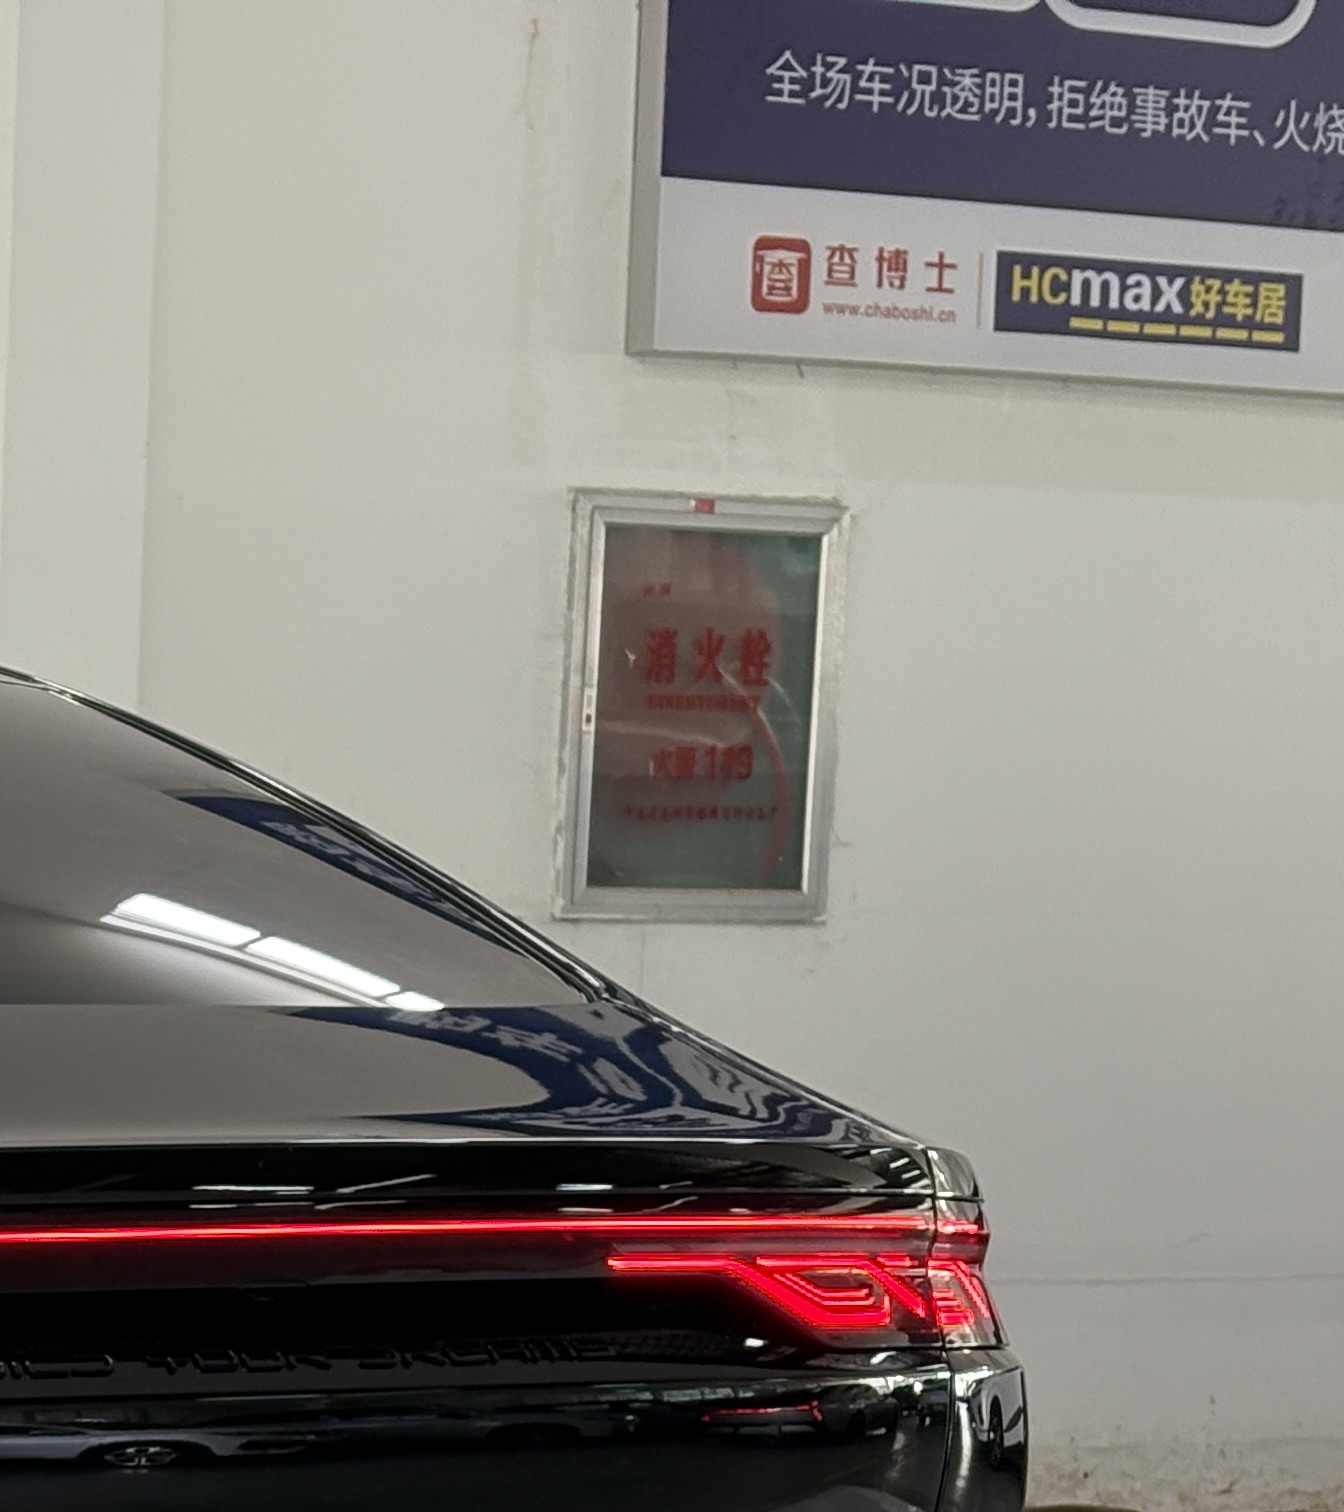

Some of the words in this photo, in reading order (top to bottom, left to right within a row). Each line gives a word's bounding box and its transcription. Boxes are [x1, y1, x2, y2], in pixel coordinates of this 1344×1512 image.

[822, 302, 957, 324] www.chaboshi.cn
[1011, 264, 1186, 314] HCmax
[1188, 275, 1286, 326] 好车居
